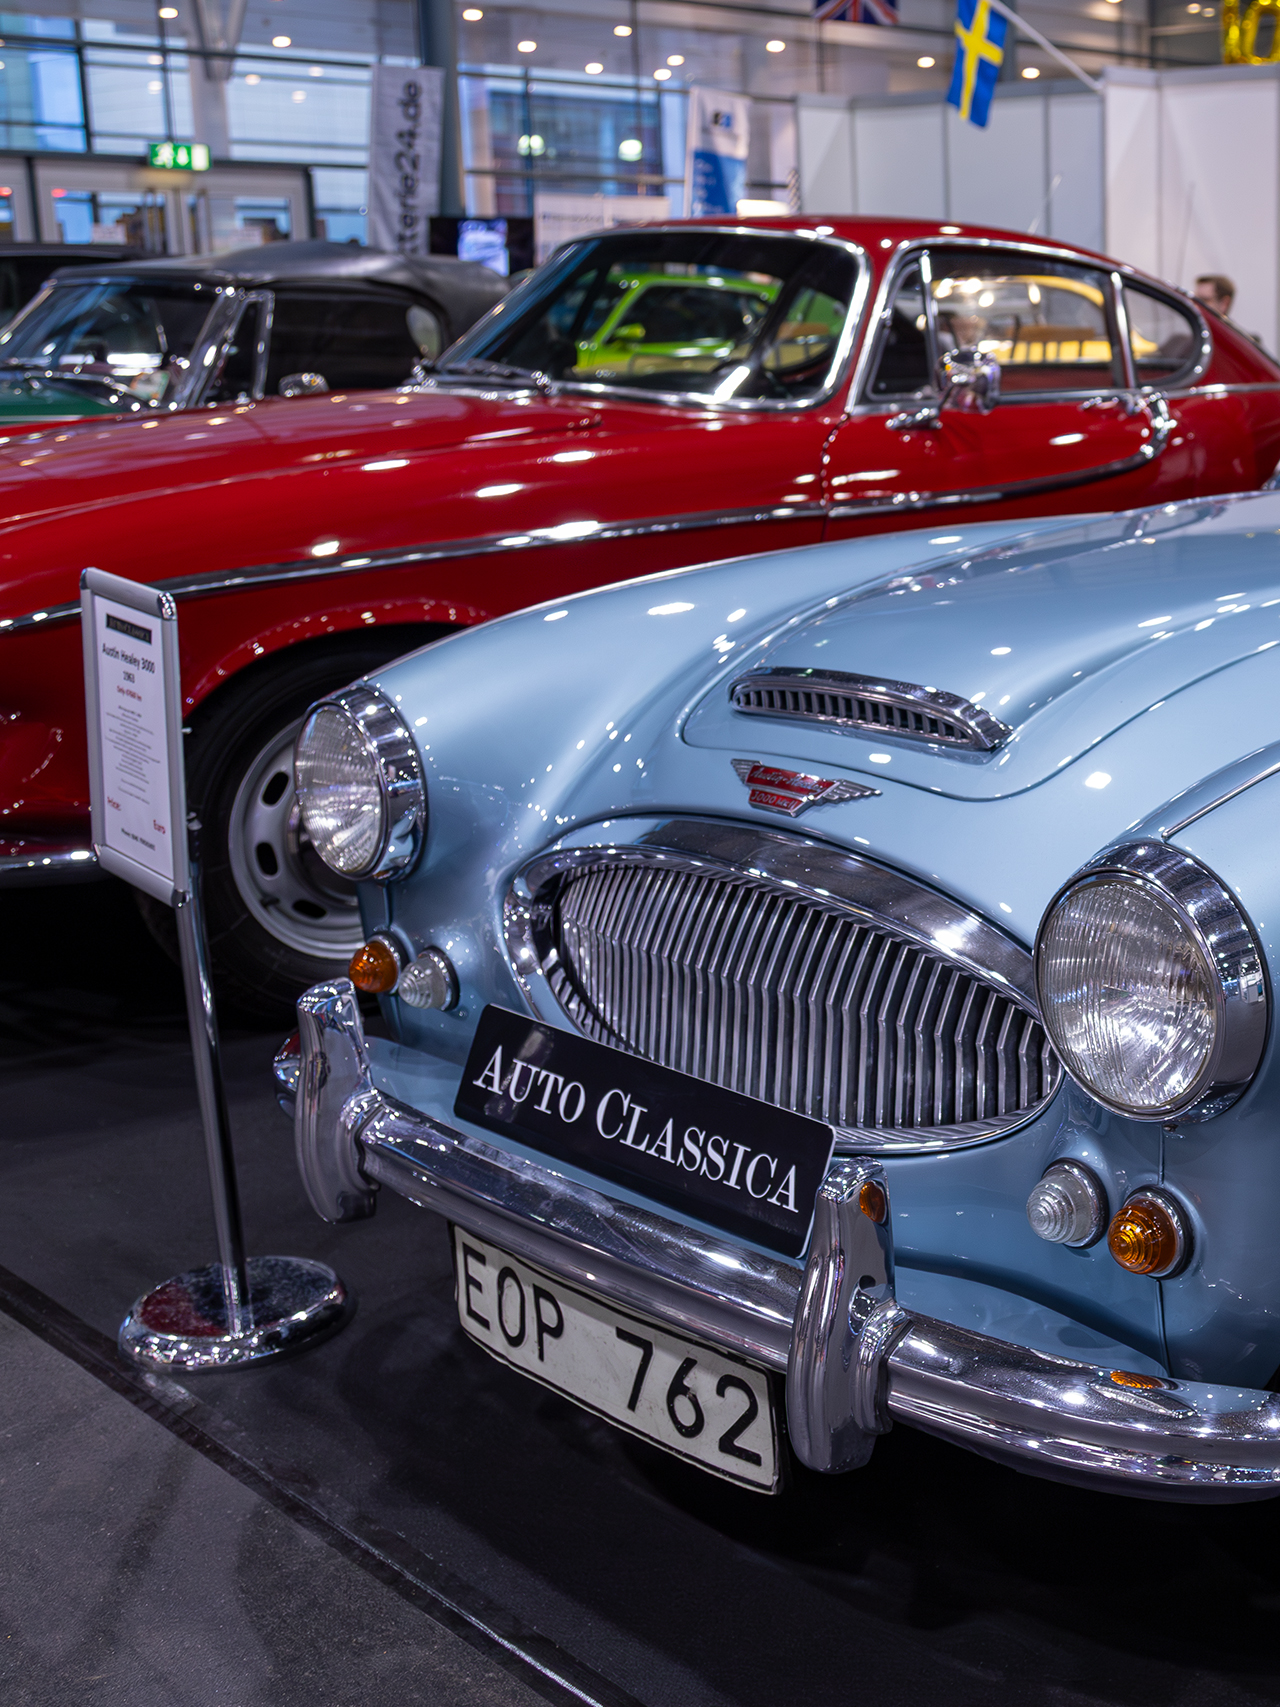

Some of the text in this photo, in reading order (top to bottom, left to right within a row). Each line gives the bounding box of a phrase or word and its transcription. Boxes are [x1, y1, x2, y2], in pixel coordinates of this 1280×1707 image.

[751, 791, 776, 804] 3000
[472, 1043, 800, 1214] AUTO CLASSICA
[462, 1241, 762, 1467] EOP 762
